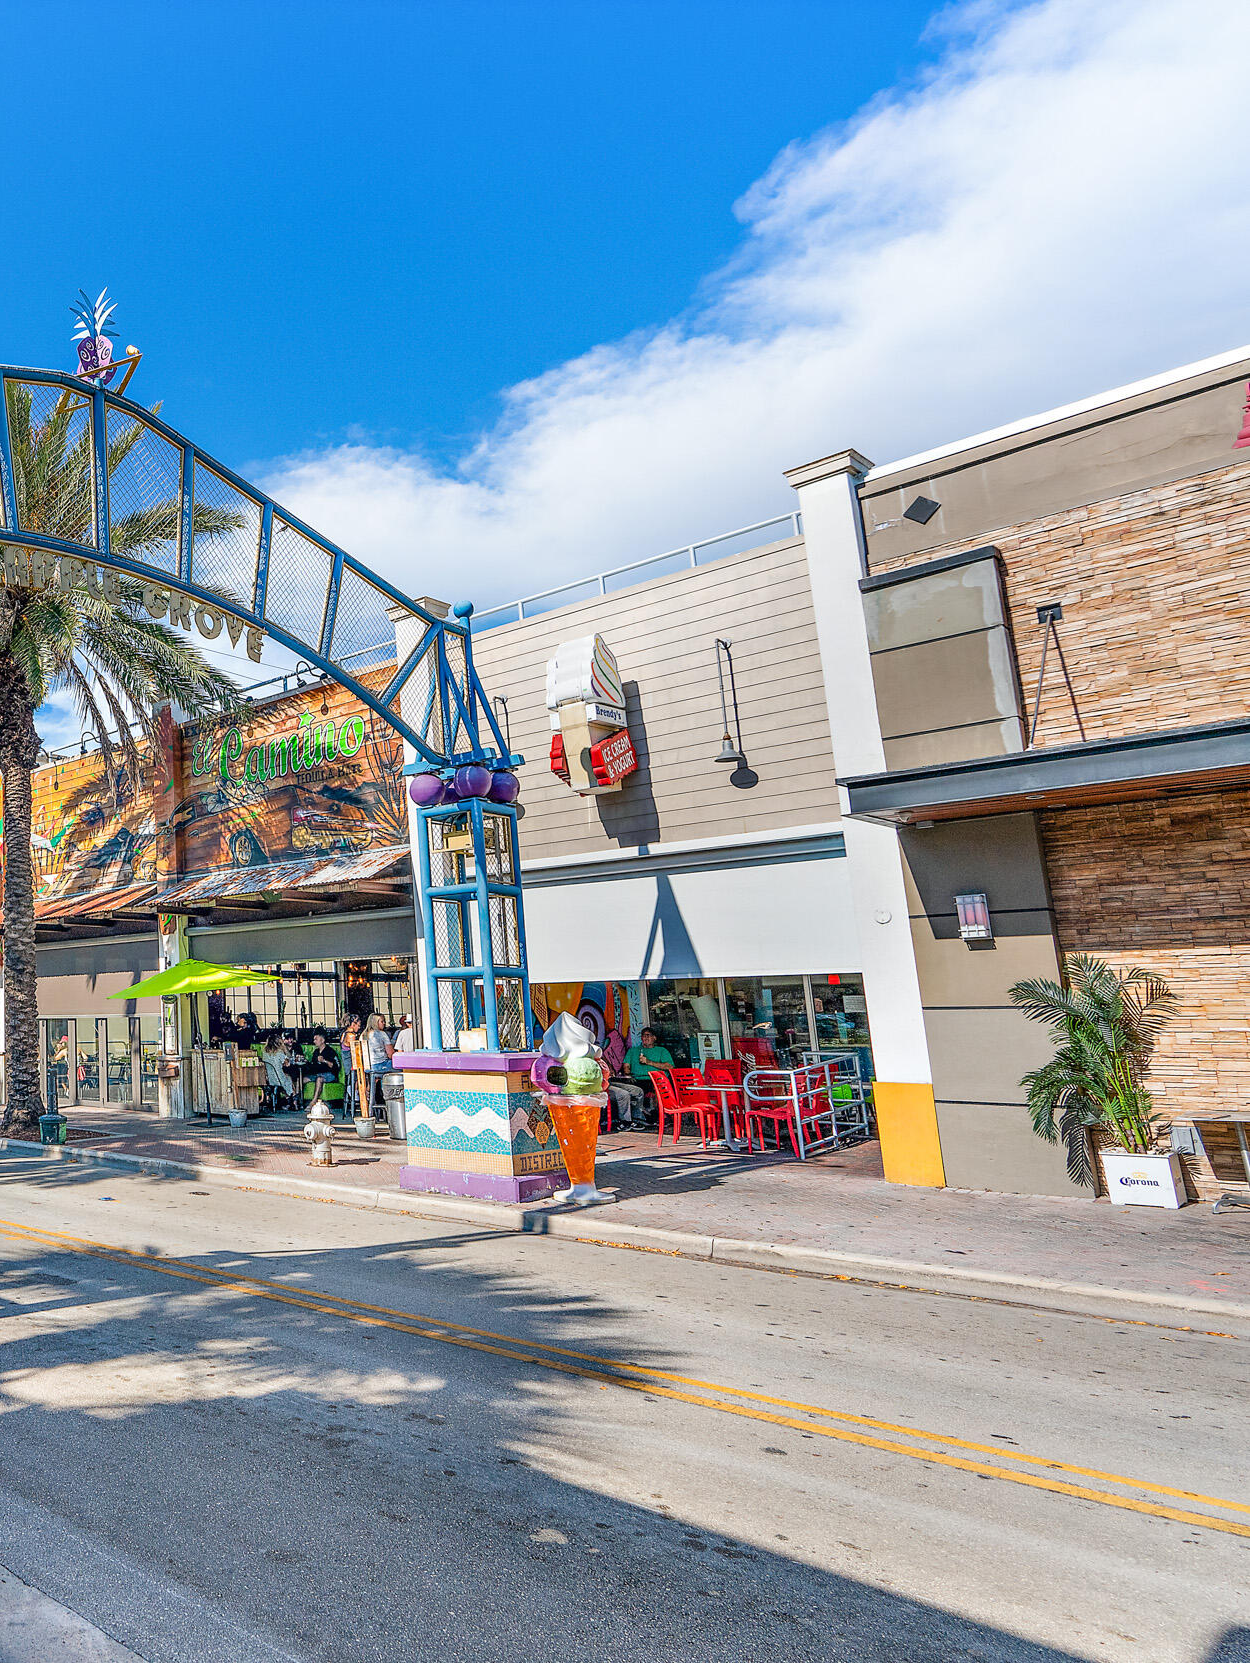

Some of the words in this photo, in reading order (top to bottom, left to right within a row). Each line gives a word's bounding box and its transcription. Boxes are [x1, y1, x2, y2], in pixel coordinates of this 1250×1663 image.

[143, 583, 264, 663] GROVE
[595, 705, 622, 720] Brendy's
[192, 735, 214, 776] El
[219, 709, 365, 788] Camino
[602, 746, 613, 763] ICE
[611, 735, 631, 757] CREAM
[295, 767, 334, 785] TEQUILA
[337, 763, 363, 779] BAR
[608, 765, 614, 778] &
[613, 750, 635, 774] YOGURT
[520, 1151, 565, 1173] DISTRIC
[1119, 1176, 1160, 1187] Corona
